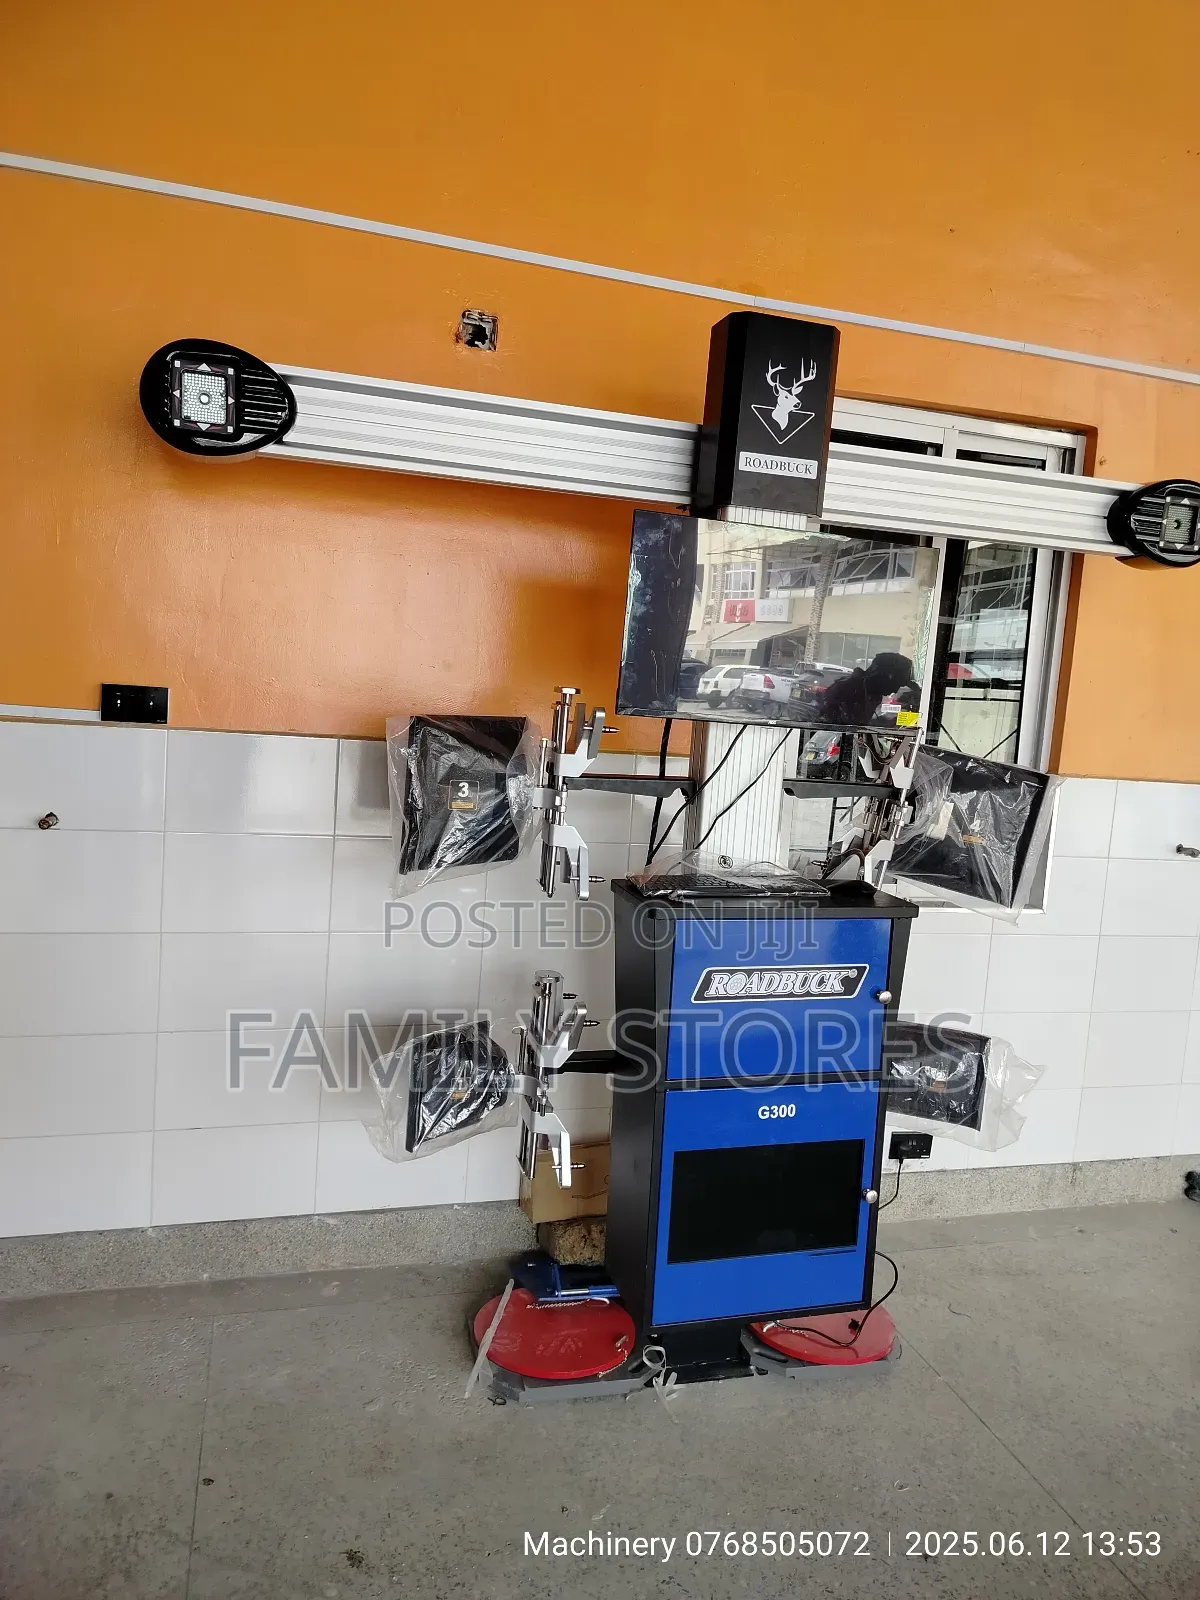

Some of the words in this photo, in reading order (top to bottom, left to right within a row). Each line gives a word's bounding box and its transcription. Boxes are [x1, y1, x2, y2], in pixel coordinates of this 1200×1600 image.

[744, 456, 813, 474] ROADBUCK
[457, 781, 469, 798] 3
[704, 969, 849, 997] ROADBUCK
[757, 1103, 797, 1120] G300
